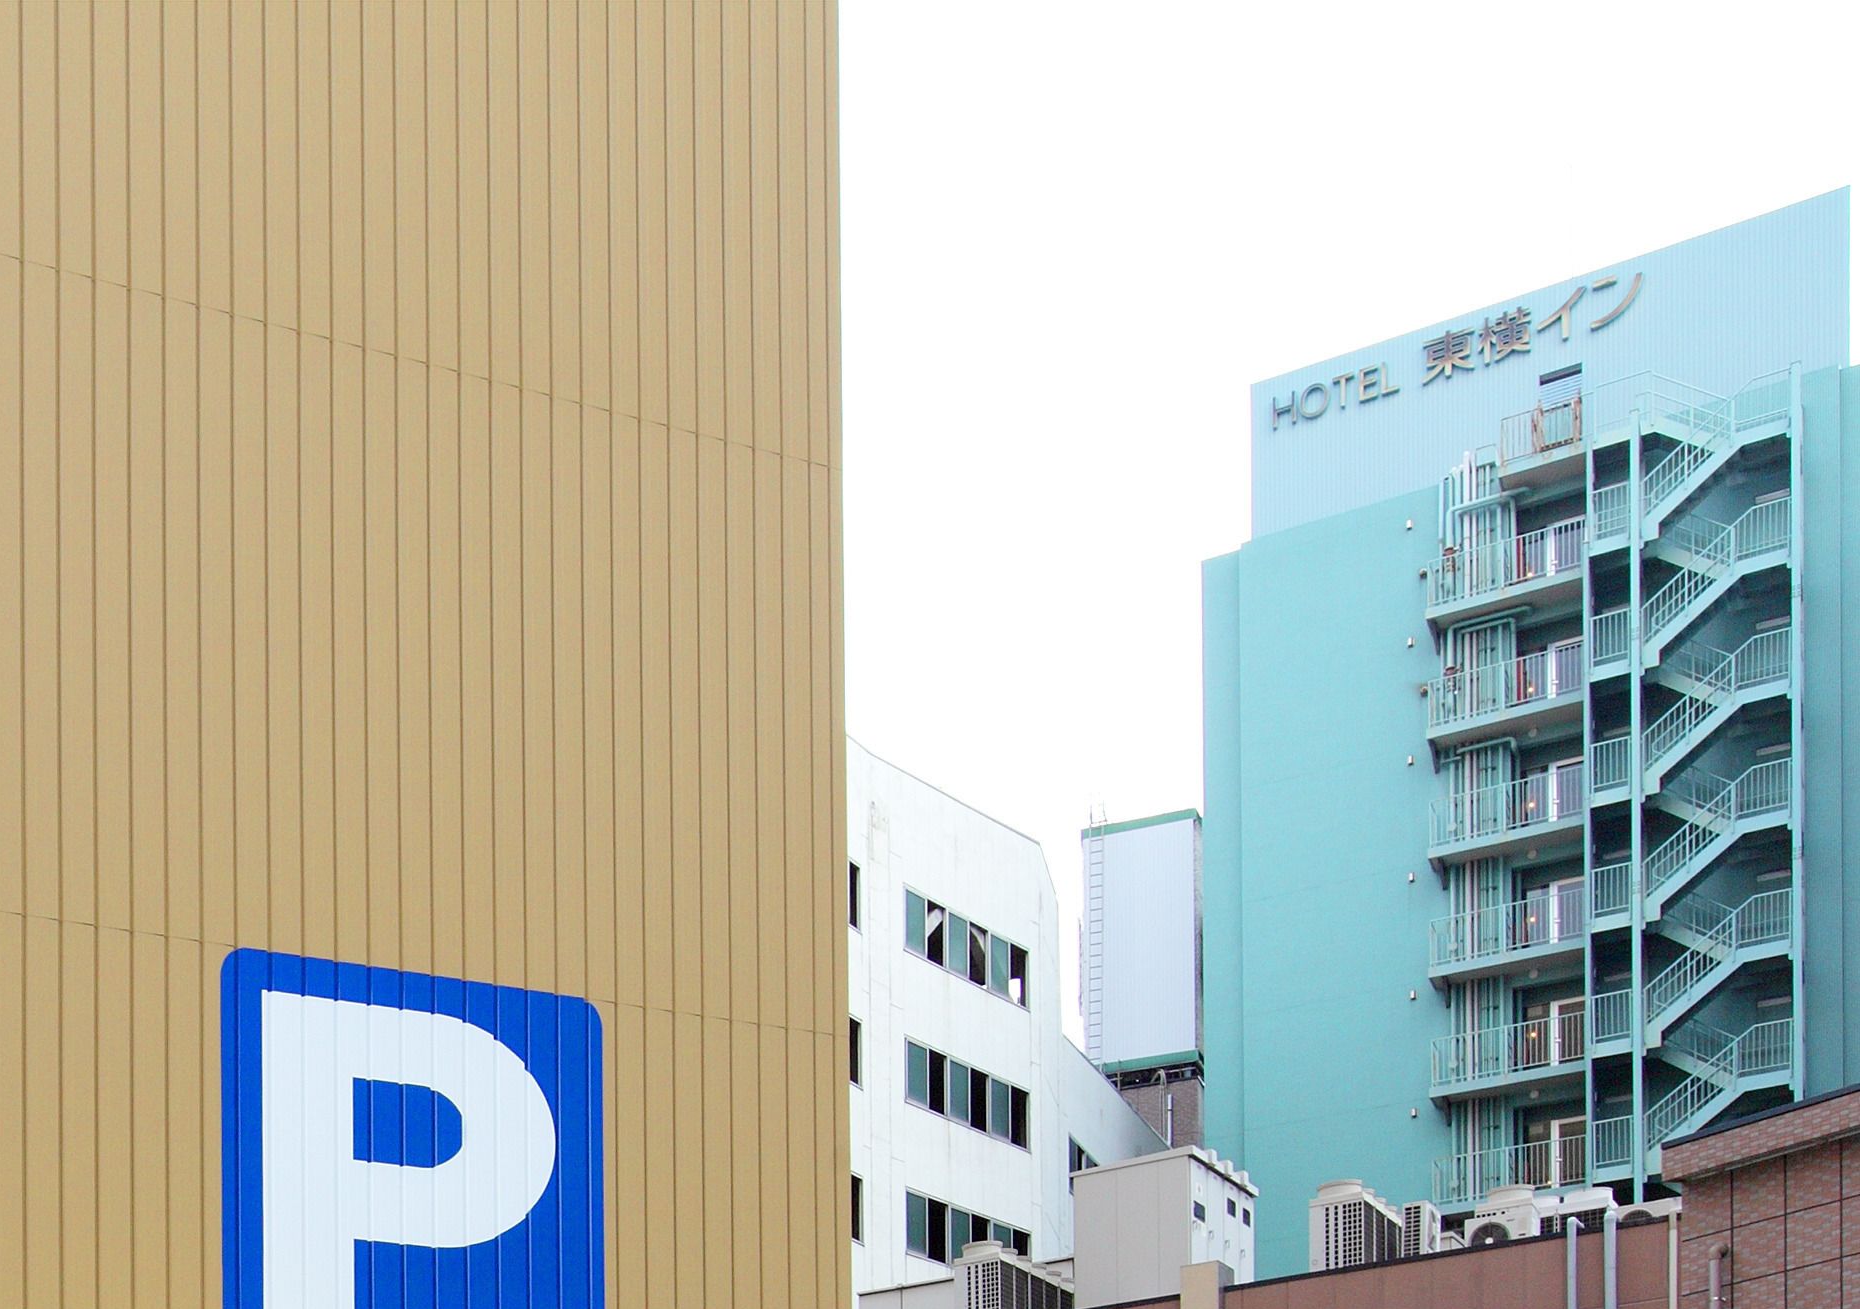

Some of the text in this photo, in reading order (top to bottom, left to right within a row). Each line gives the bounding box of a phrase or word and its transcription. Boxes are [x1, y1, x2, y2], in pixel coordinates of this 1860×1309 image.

[1272, 272, 1643, 431] HOTEL 東横イン
